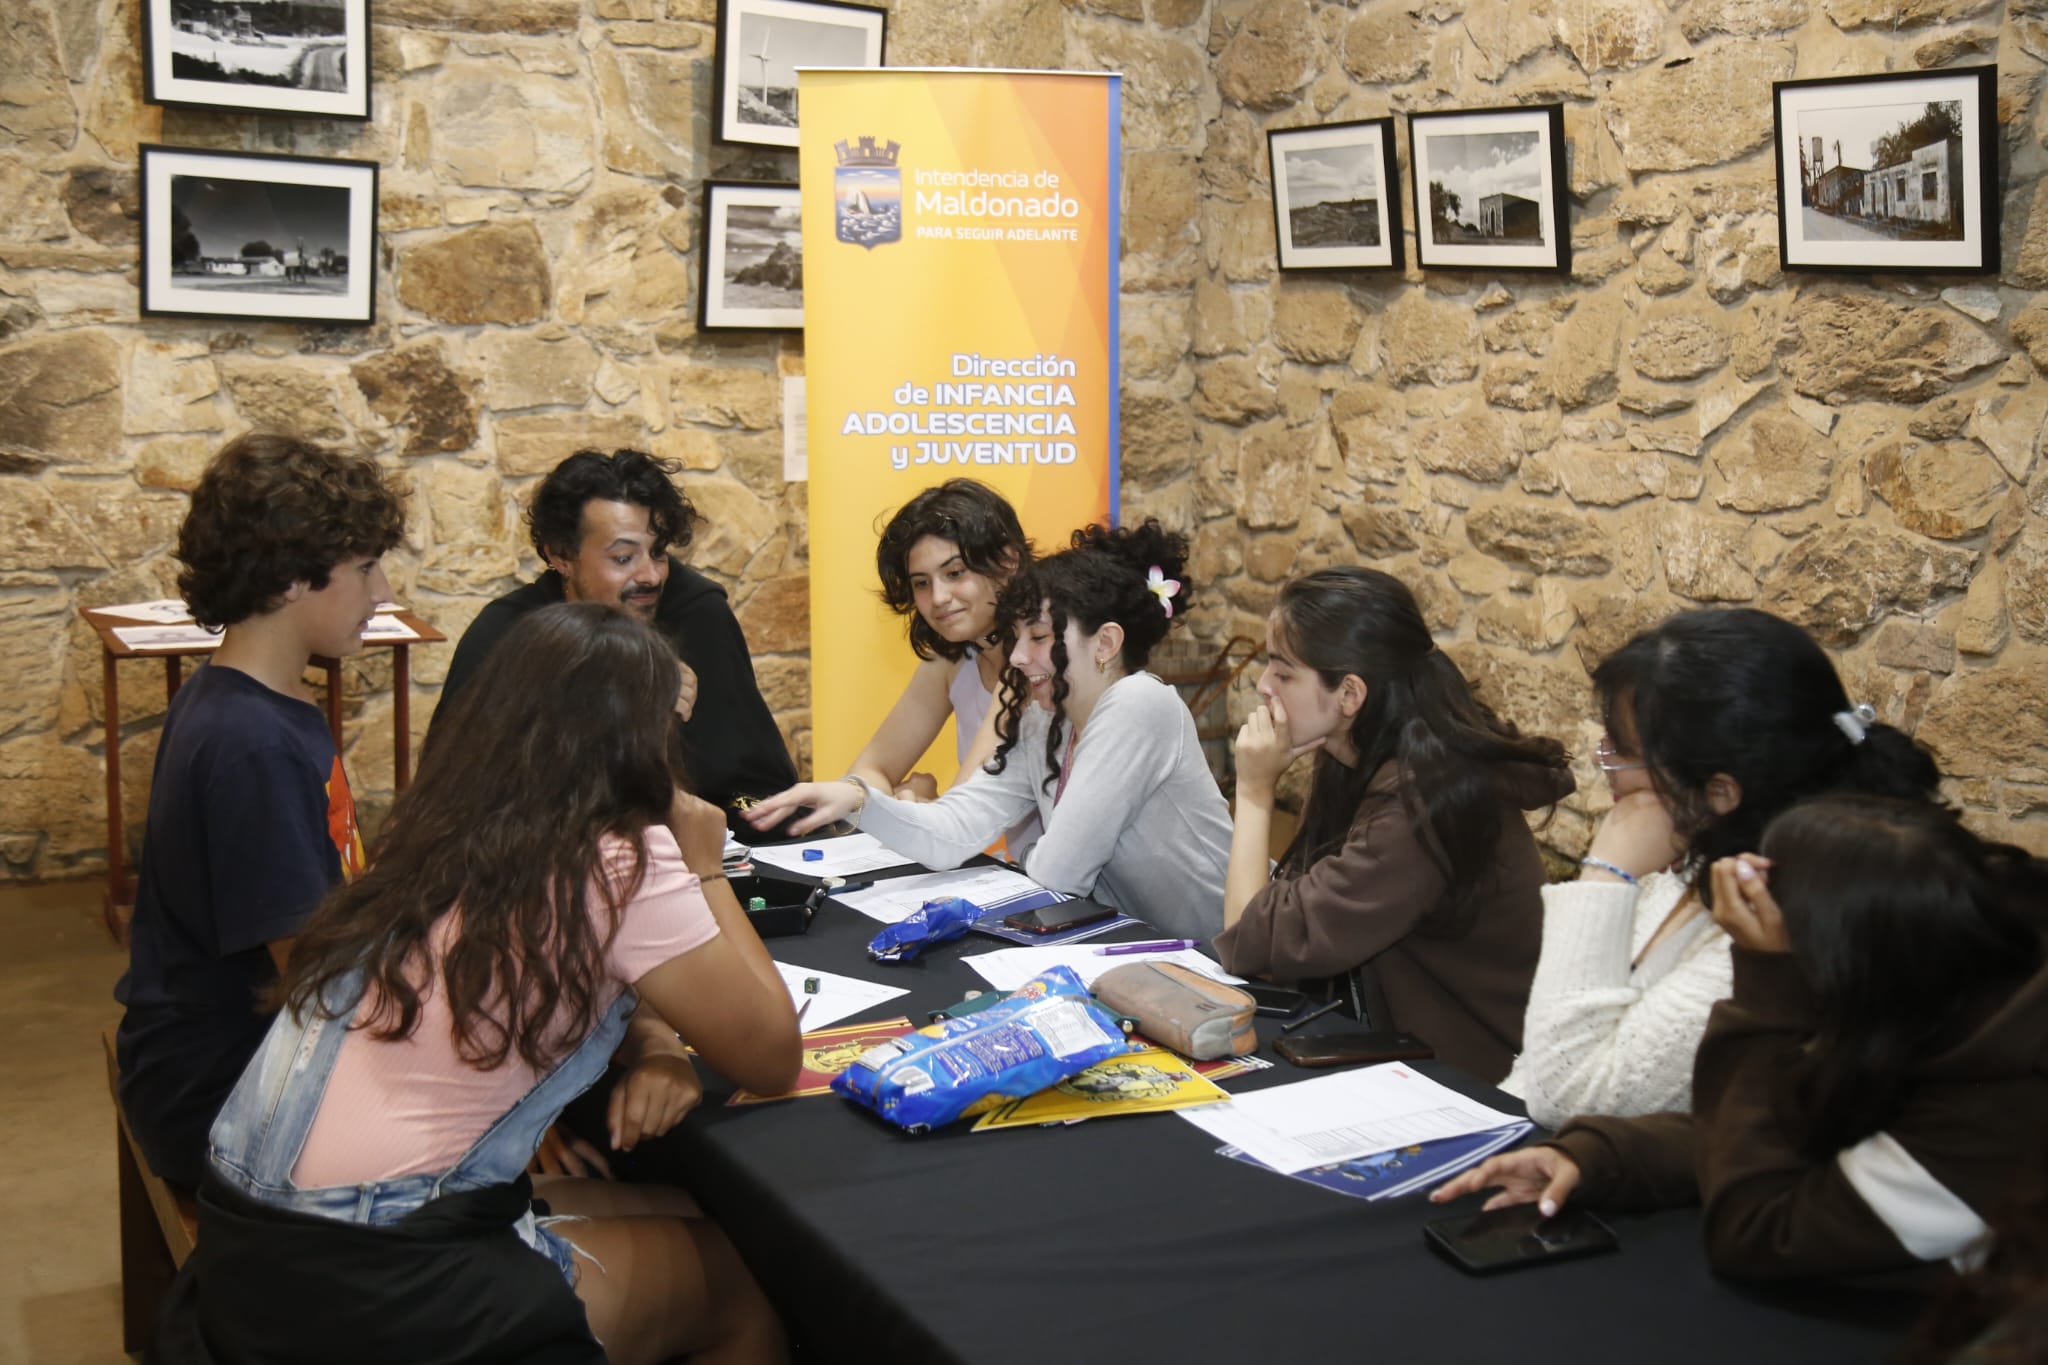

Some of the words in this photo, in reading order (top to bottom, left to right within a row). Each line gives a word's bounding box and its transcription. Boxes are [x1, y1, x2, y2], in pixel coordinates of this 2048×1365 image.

[915, 168, 1028, 188] Intendencia
[1034, 170, 1059, 189] de
[915, 190, 1079, 218] Maldonado
[916, 226, 953, 240] PARA
[955, 226, 1003, 241] SEGUIR
[1006, 227, 1079, 242] ADELANTE
[951, 354, 1076, 377] Dirección
[894, 382, 929, 405] de
[935, 384, 1076, 406] INFANCIA
[842, 413, 1076, 435] ADOLESCENCIA
[891, 446, 908, 470] y
[914, 442, 1077, 464] JUVENTUD
